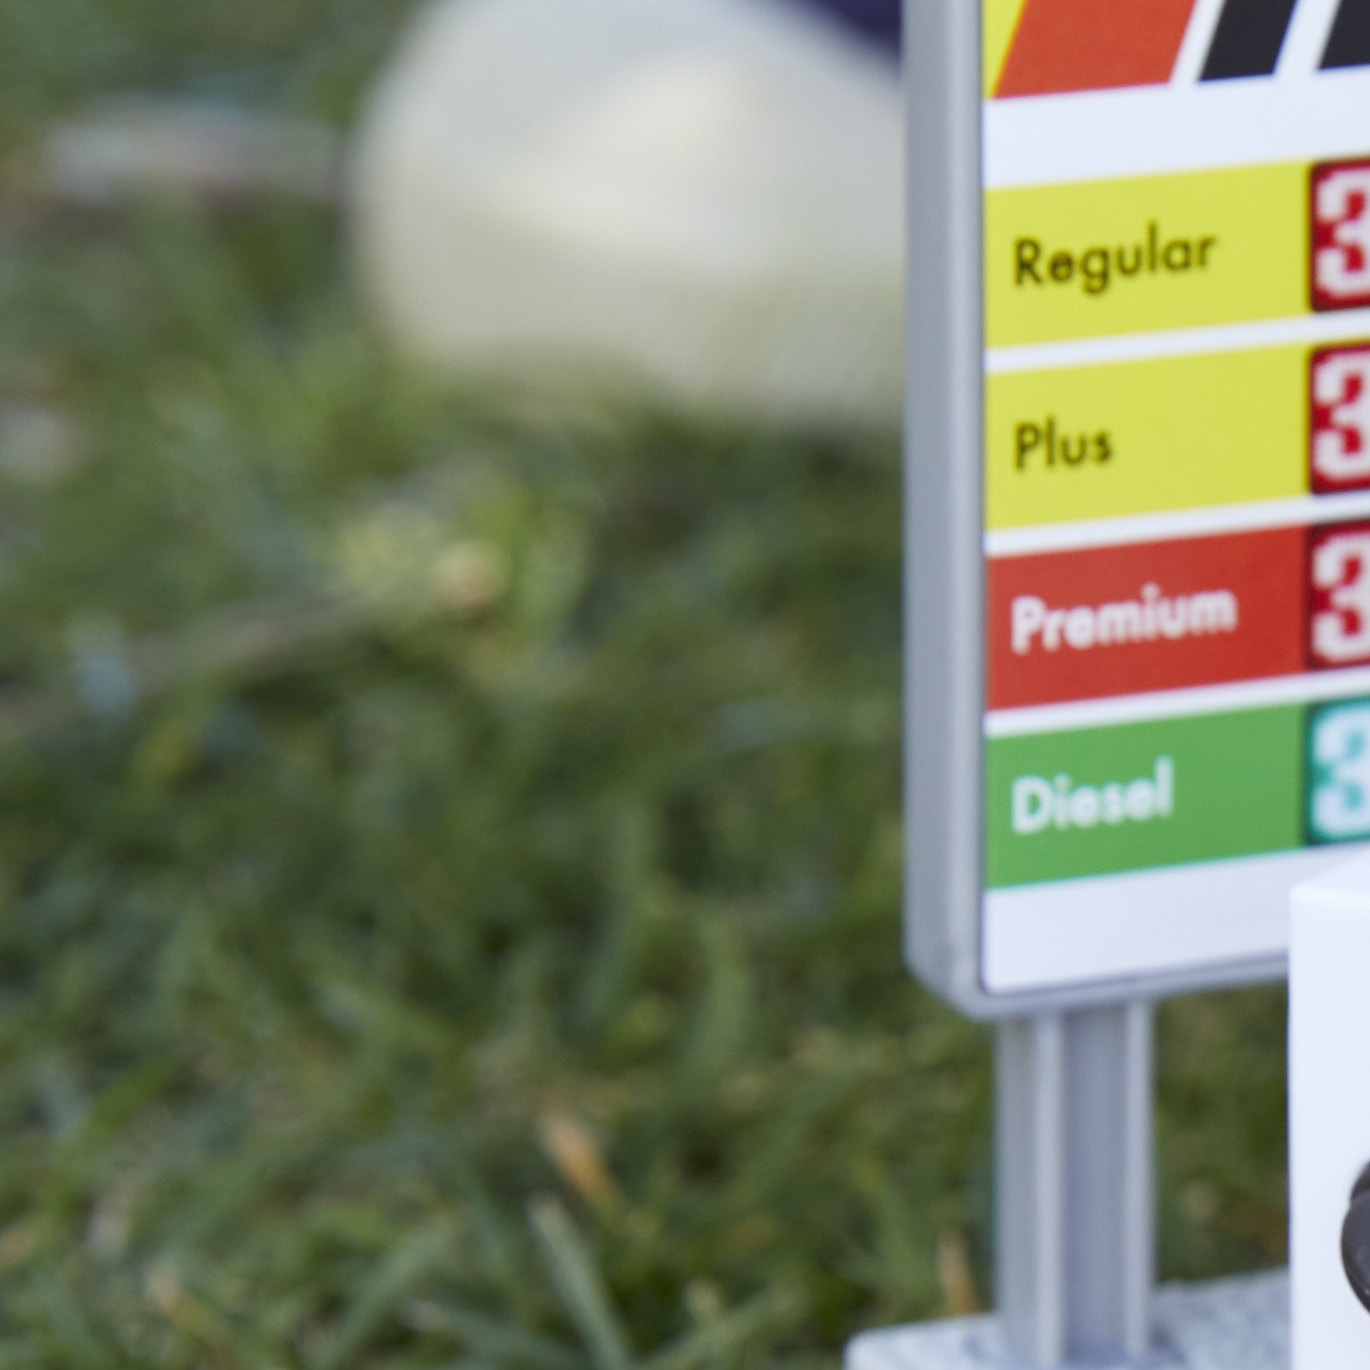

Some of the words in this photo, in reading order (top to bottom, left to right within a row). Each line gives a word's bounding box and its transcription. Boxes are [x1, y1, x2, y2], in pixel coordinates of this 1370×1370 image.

[1013, 220, 1218, 294] Regular
[1013, 416, 1114, 471] Plus
[1011, 581, 1239, 655] Premium
[1011, 754, 1175, 834] Diesel
